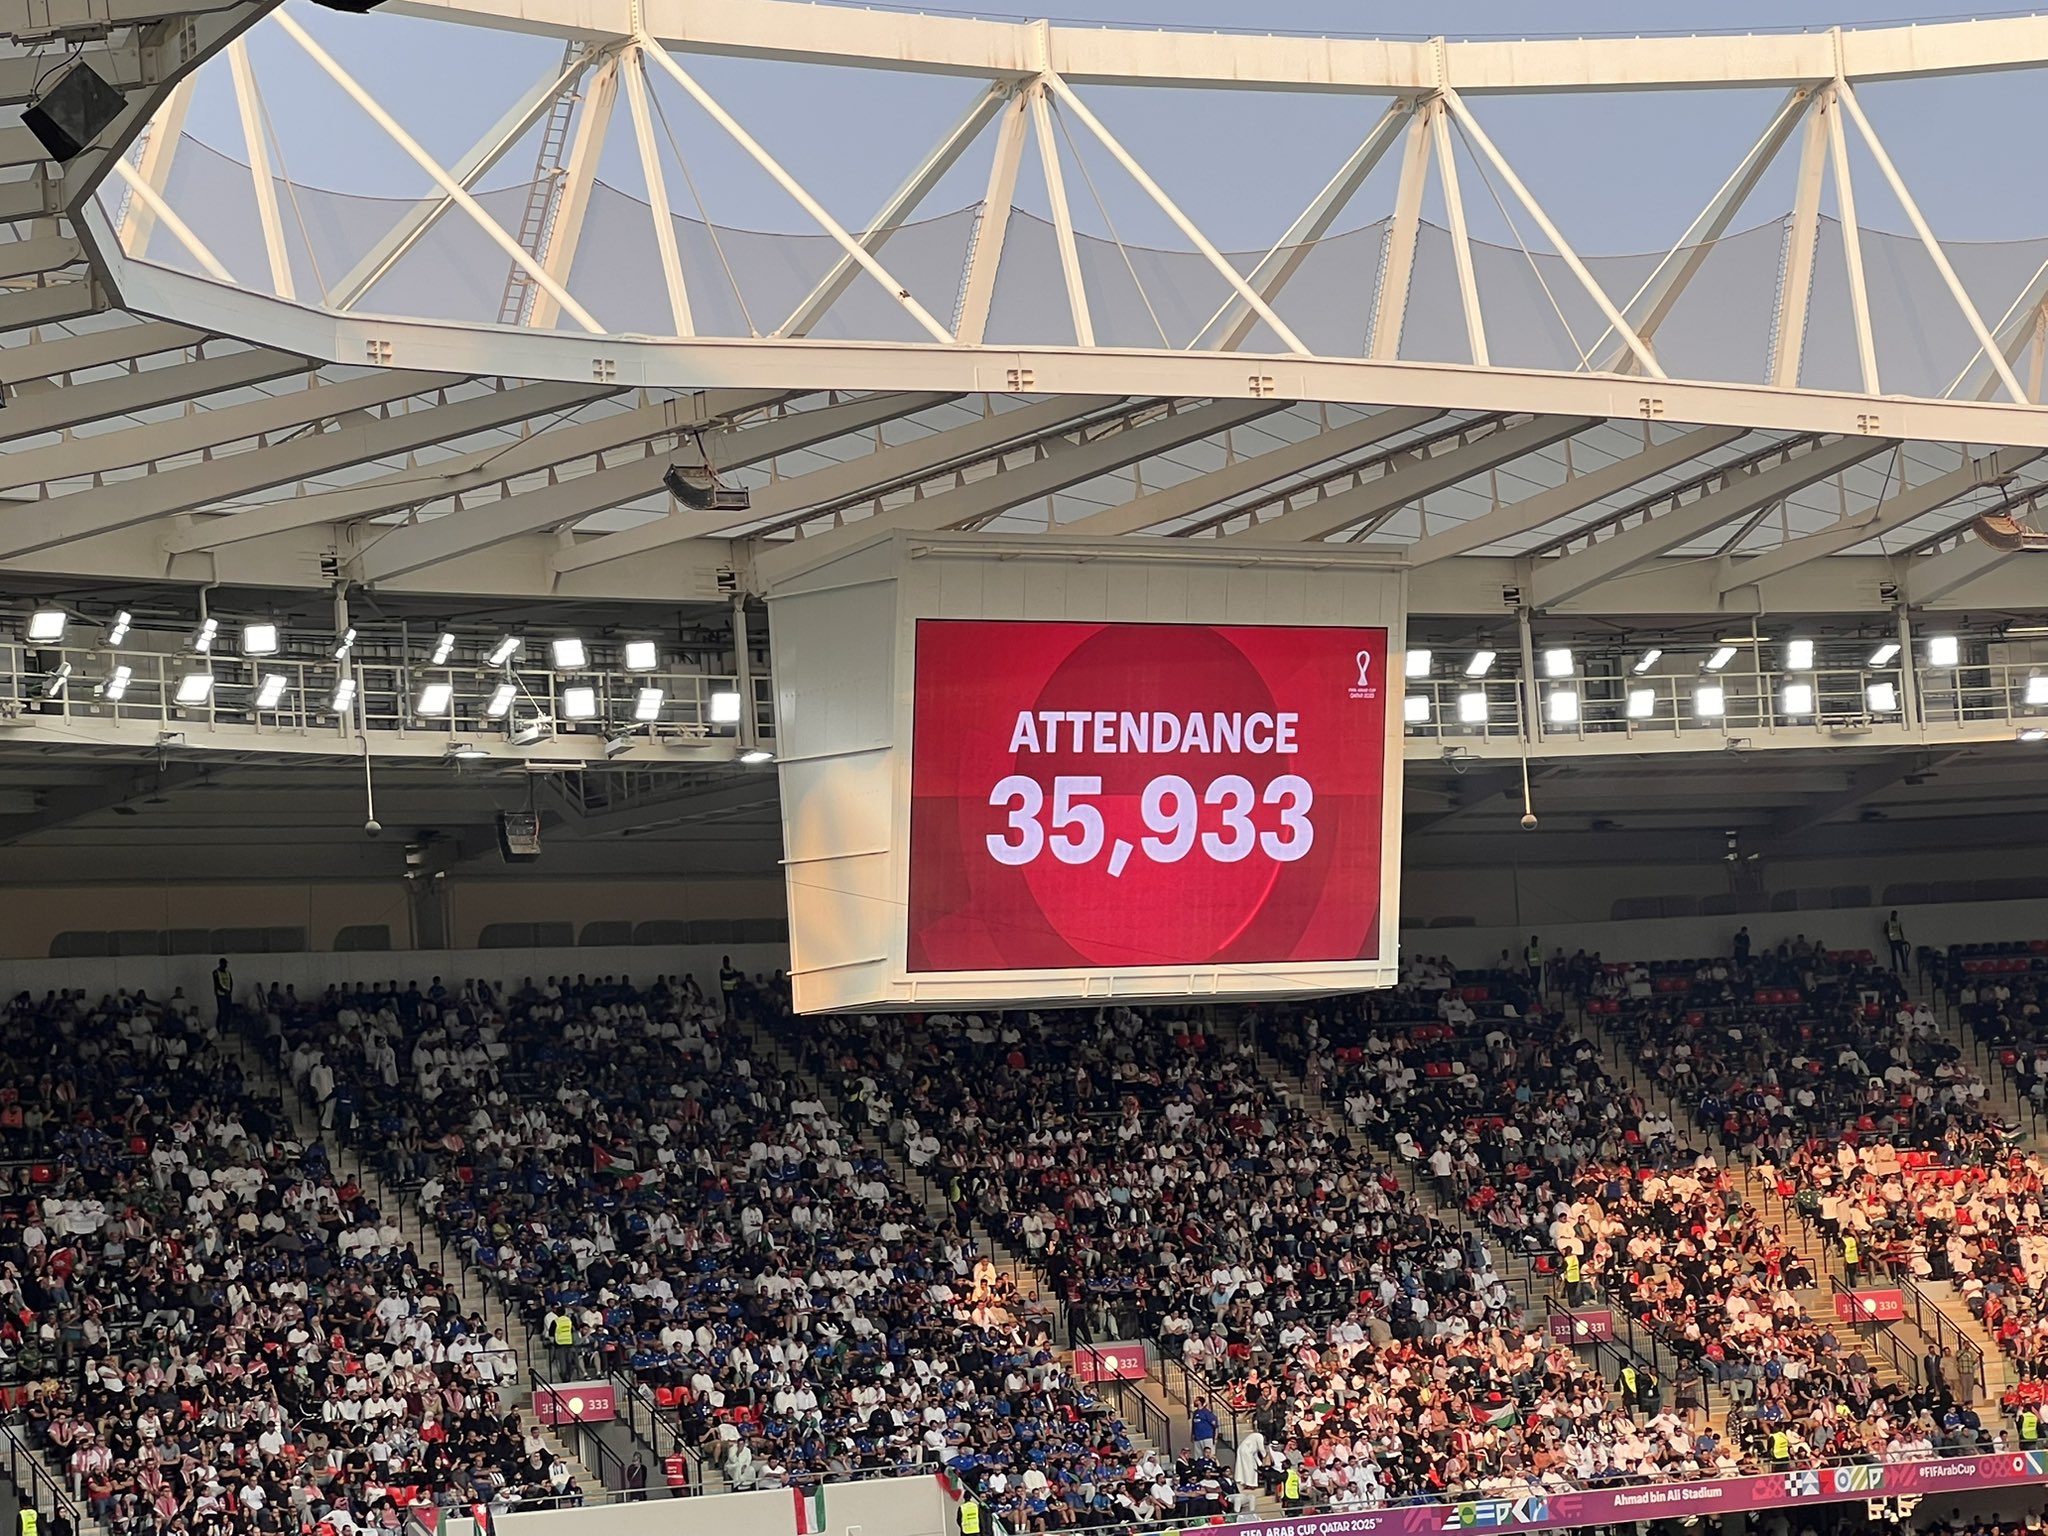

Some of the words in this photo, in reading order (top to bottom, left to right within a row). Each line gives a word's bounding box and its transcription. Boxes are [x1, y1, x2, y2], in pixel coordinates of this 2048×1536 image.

[1008, 711, 1299, 754] ATTENDANCE
[986, 775, 1315, 878] 35,933
[1879, 1301, 1898, 1311] 330
[1590, 1322, 1606, 1333] 331
[1120, 1358, 1138, 1369] 332
[588, 1399, 609, 1411] 333
[1614, 1492, 1649, 1506] Ahmad
[1649, 1490, 1667, 1503] bin
[1667, 1488, 1681, 1502] Ali
[1682, 1487, 1723, 1500] Stadium
[1266, 1526, 1295, 1536] ARAB
[1297, 1524, 1318, 1536] CUP
[1319, 1521, 1351, 1536] QATAR
